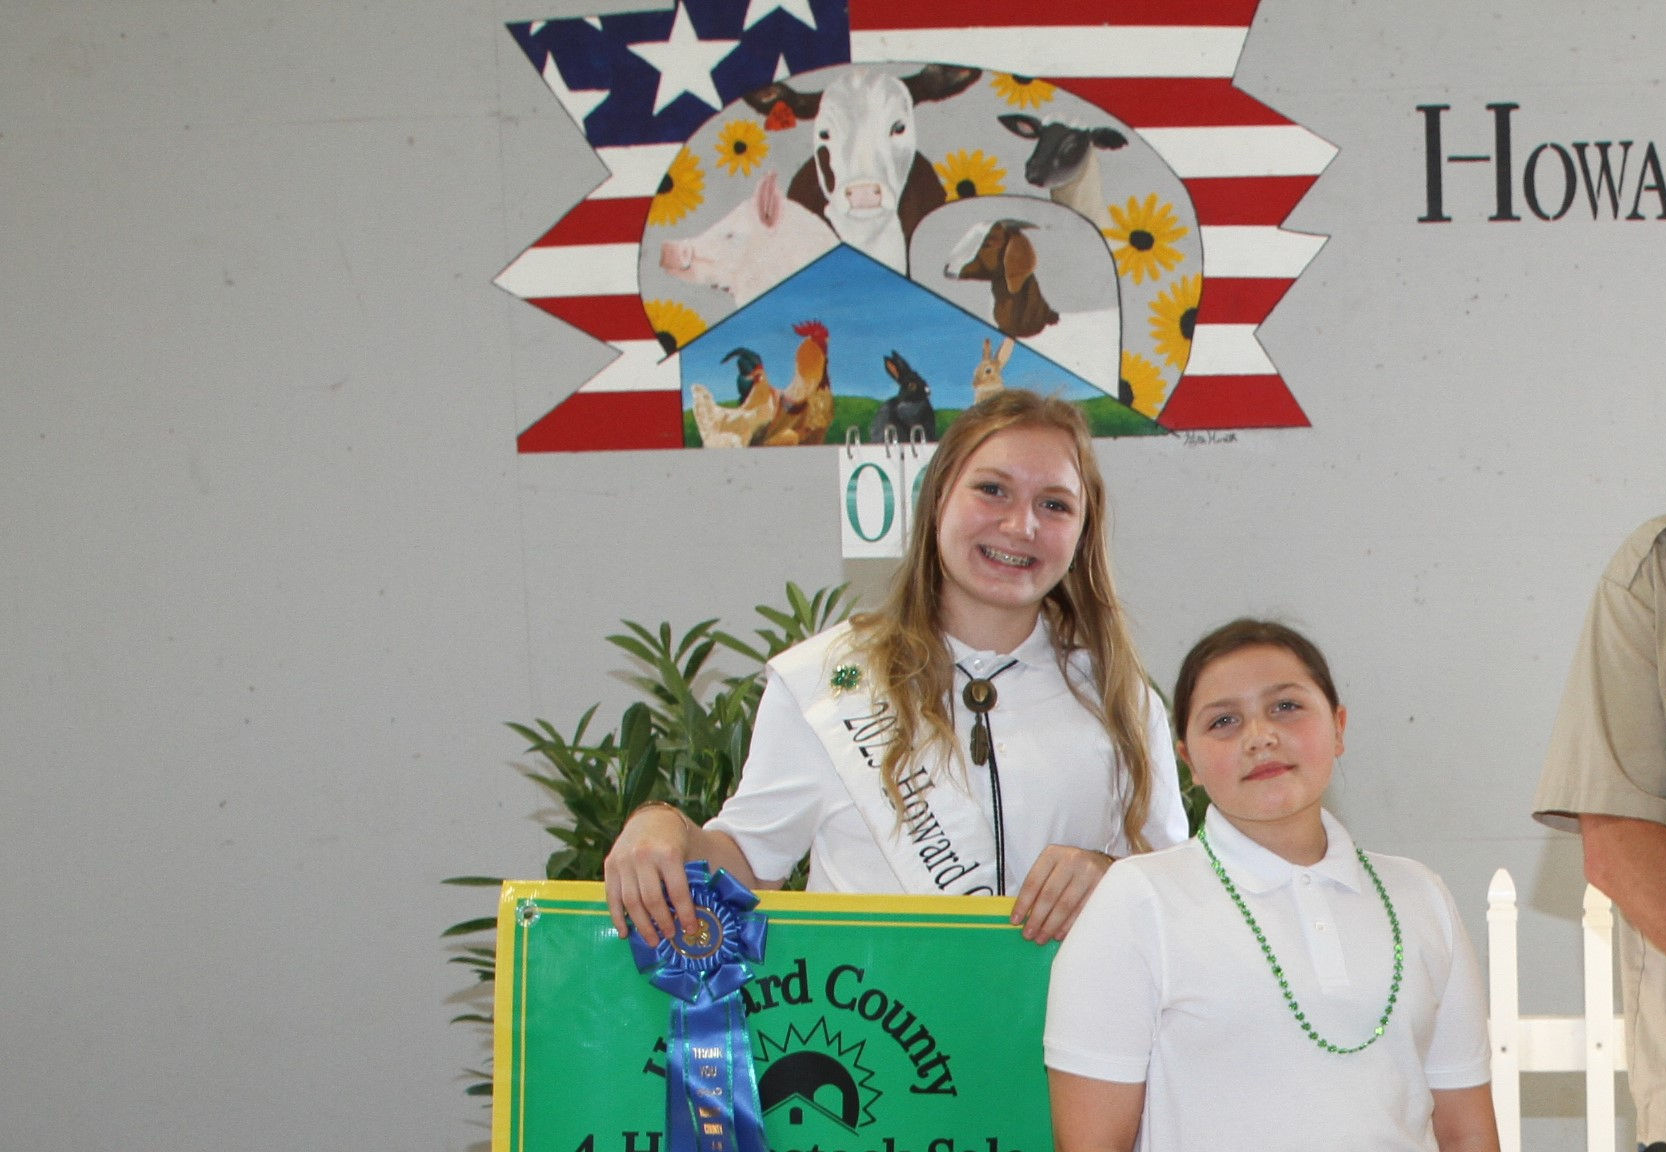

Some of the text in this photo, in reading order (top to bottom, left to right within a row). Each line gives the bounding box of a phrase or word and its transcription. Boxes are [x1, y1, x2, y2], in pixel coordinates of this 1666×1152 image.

[843, 701, 900, 769] 202
[883, 765, 980, 891] Howard
[825, 963, 957, 1099] County
